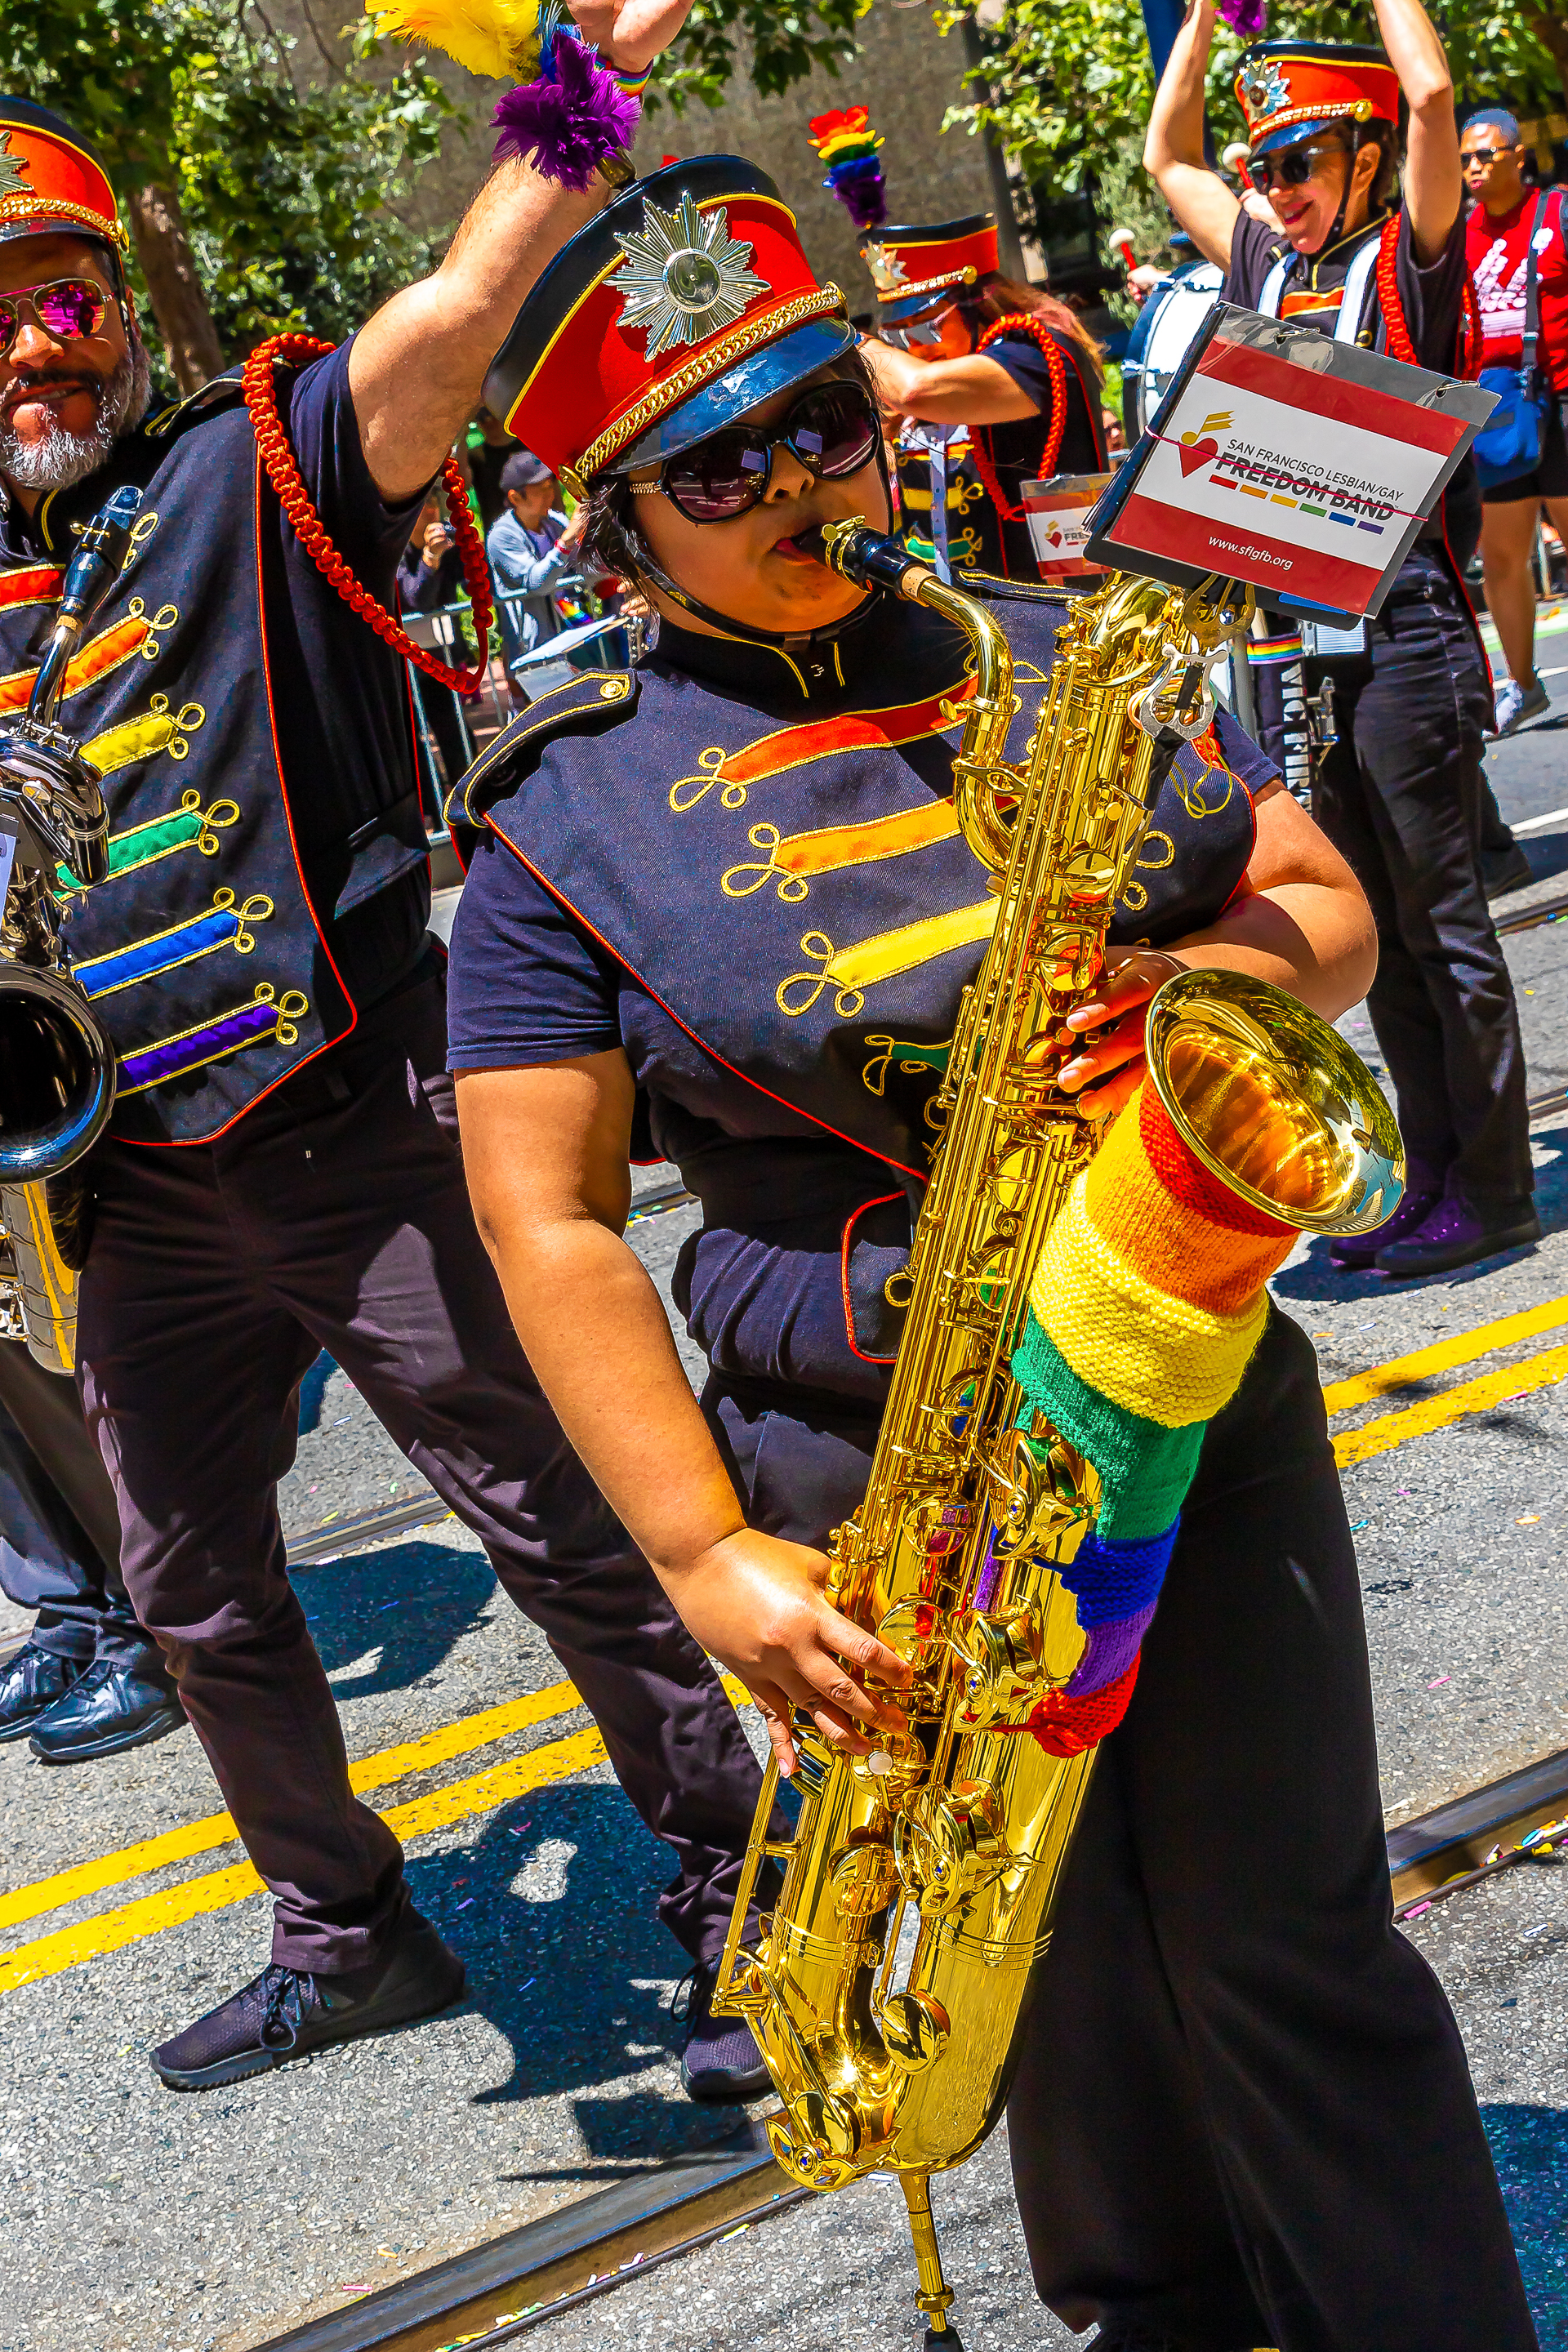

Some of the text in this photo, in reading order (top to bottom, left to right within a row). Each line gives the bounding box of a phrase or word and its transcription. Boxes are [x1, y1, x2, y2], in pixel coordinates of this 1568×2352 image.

[1215, 452, 1396, 521] FREEDOM BAND
[1227, 439, 1404, 501] SAN FRANCISCO LESBIAN/GAY
[1064, 531, 1090, 541] FRE
[1208, 536, 1294, 571] www.sflgfb.org
[1281, 662, 1313, 817] VIC FIRT
